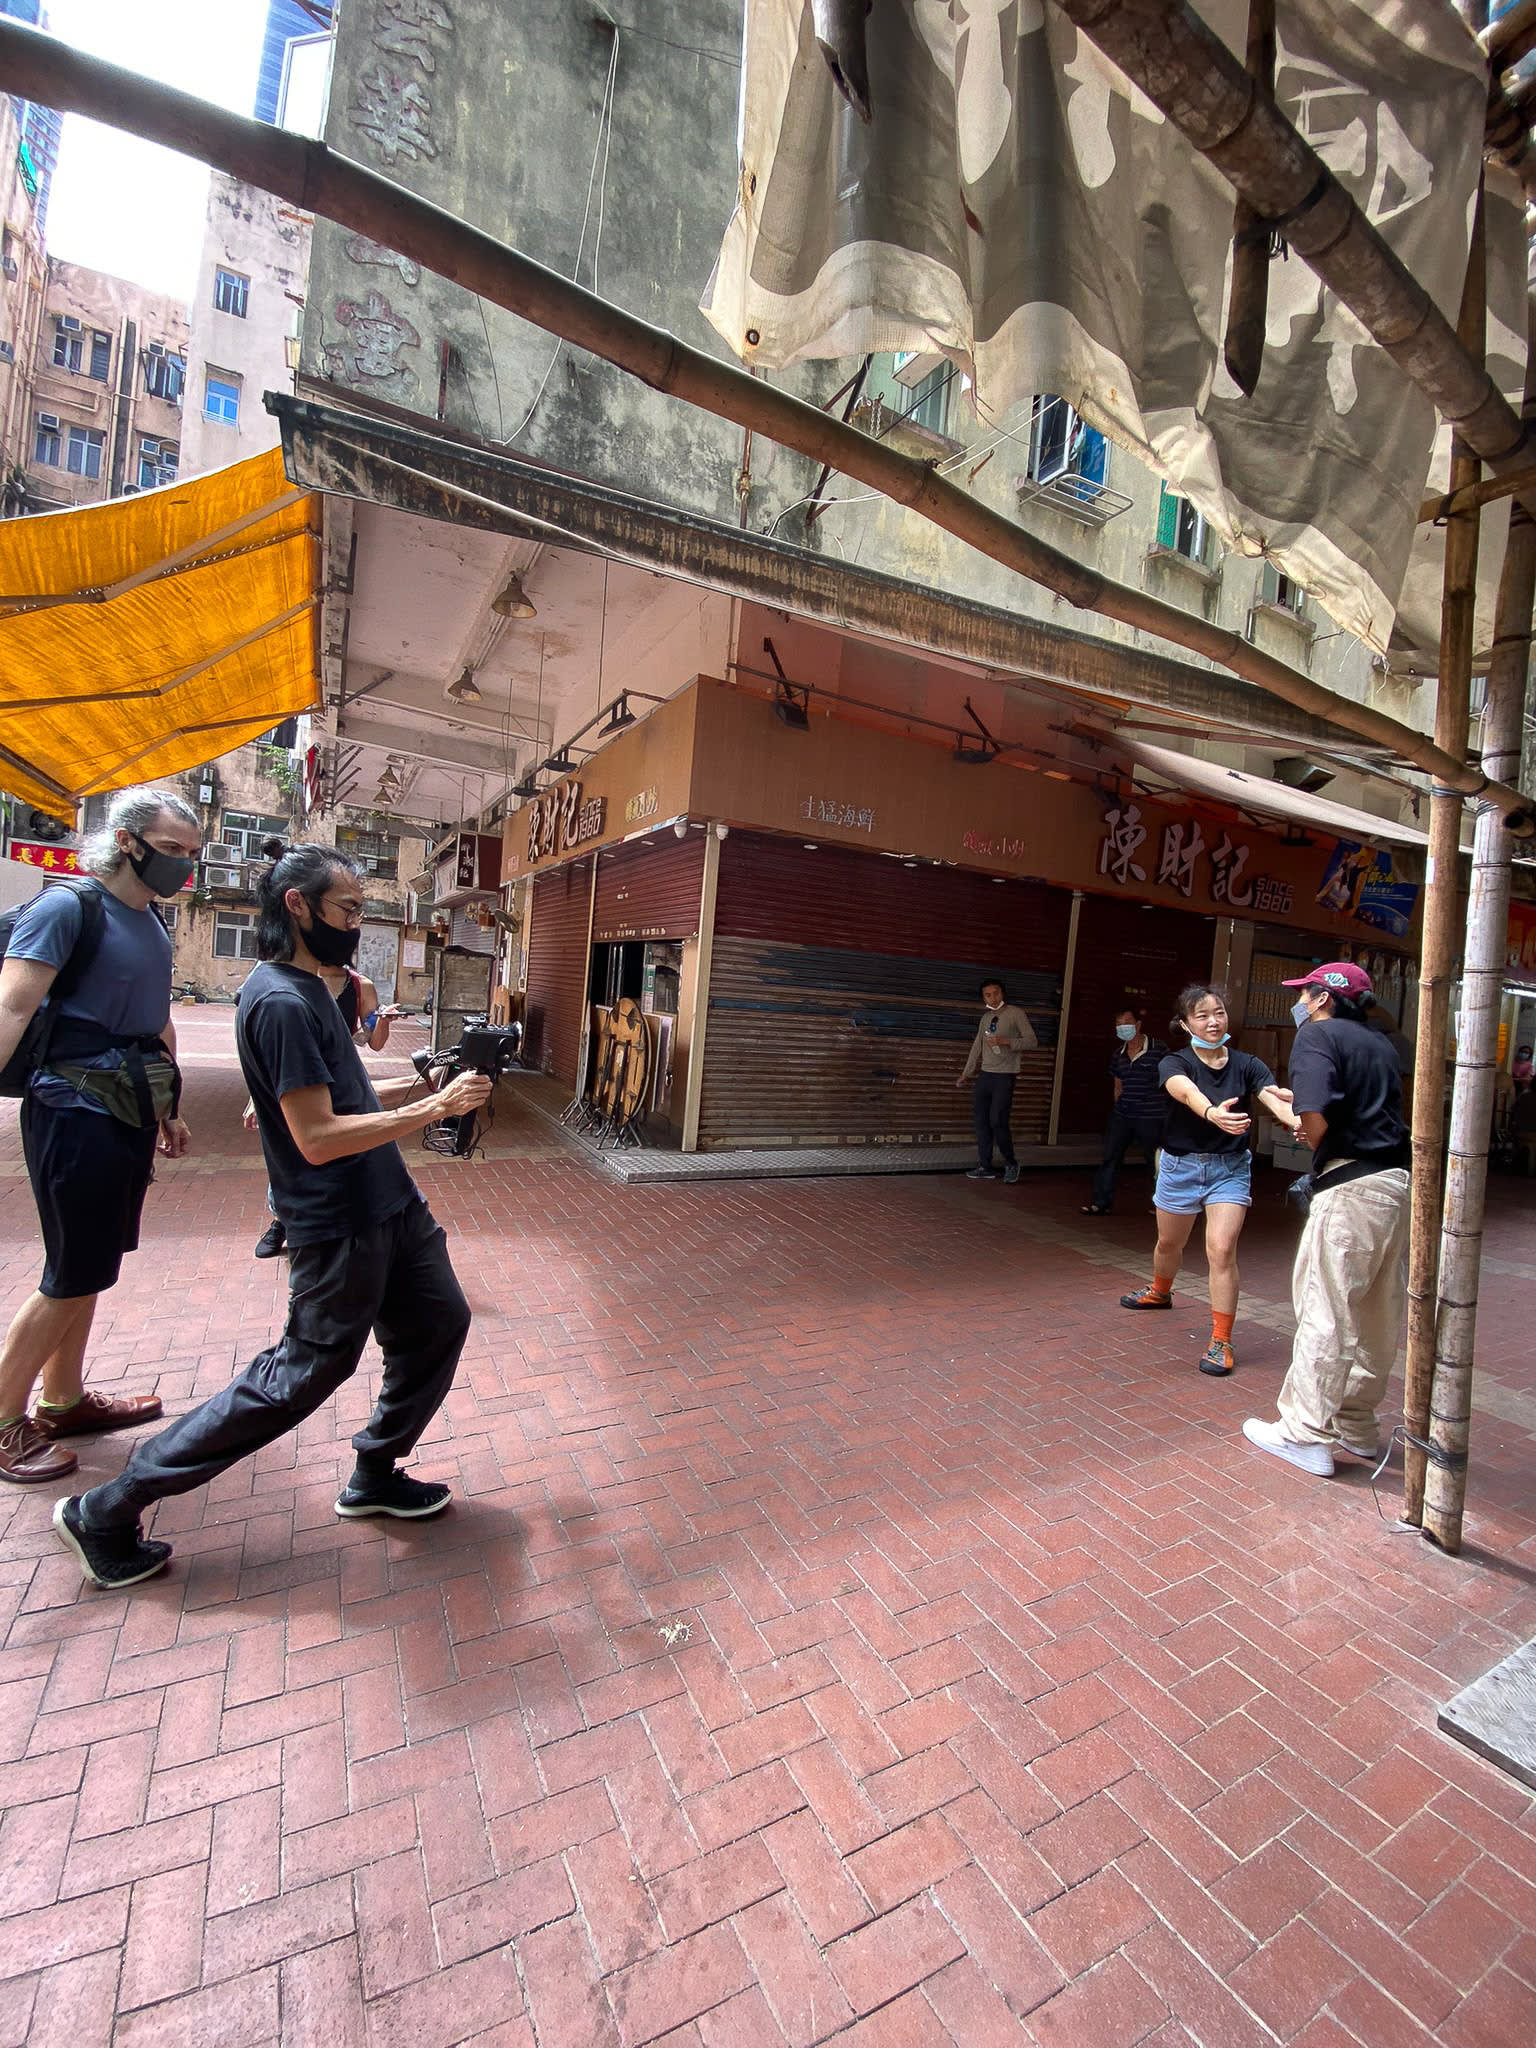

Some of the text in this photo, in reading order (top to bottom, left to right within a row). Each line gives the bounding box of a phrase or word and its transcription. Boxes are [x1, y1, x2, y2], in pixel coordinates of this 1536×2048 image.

[578, 814, 601, 843] 1980
[799, 794, 877, 833] 生猛海鮮
[1100, 804, 1254, 906] 陳財記
[1253, 889, 1294, 914] 1980
